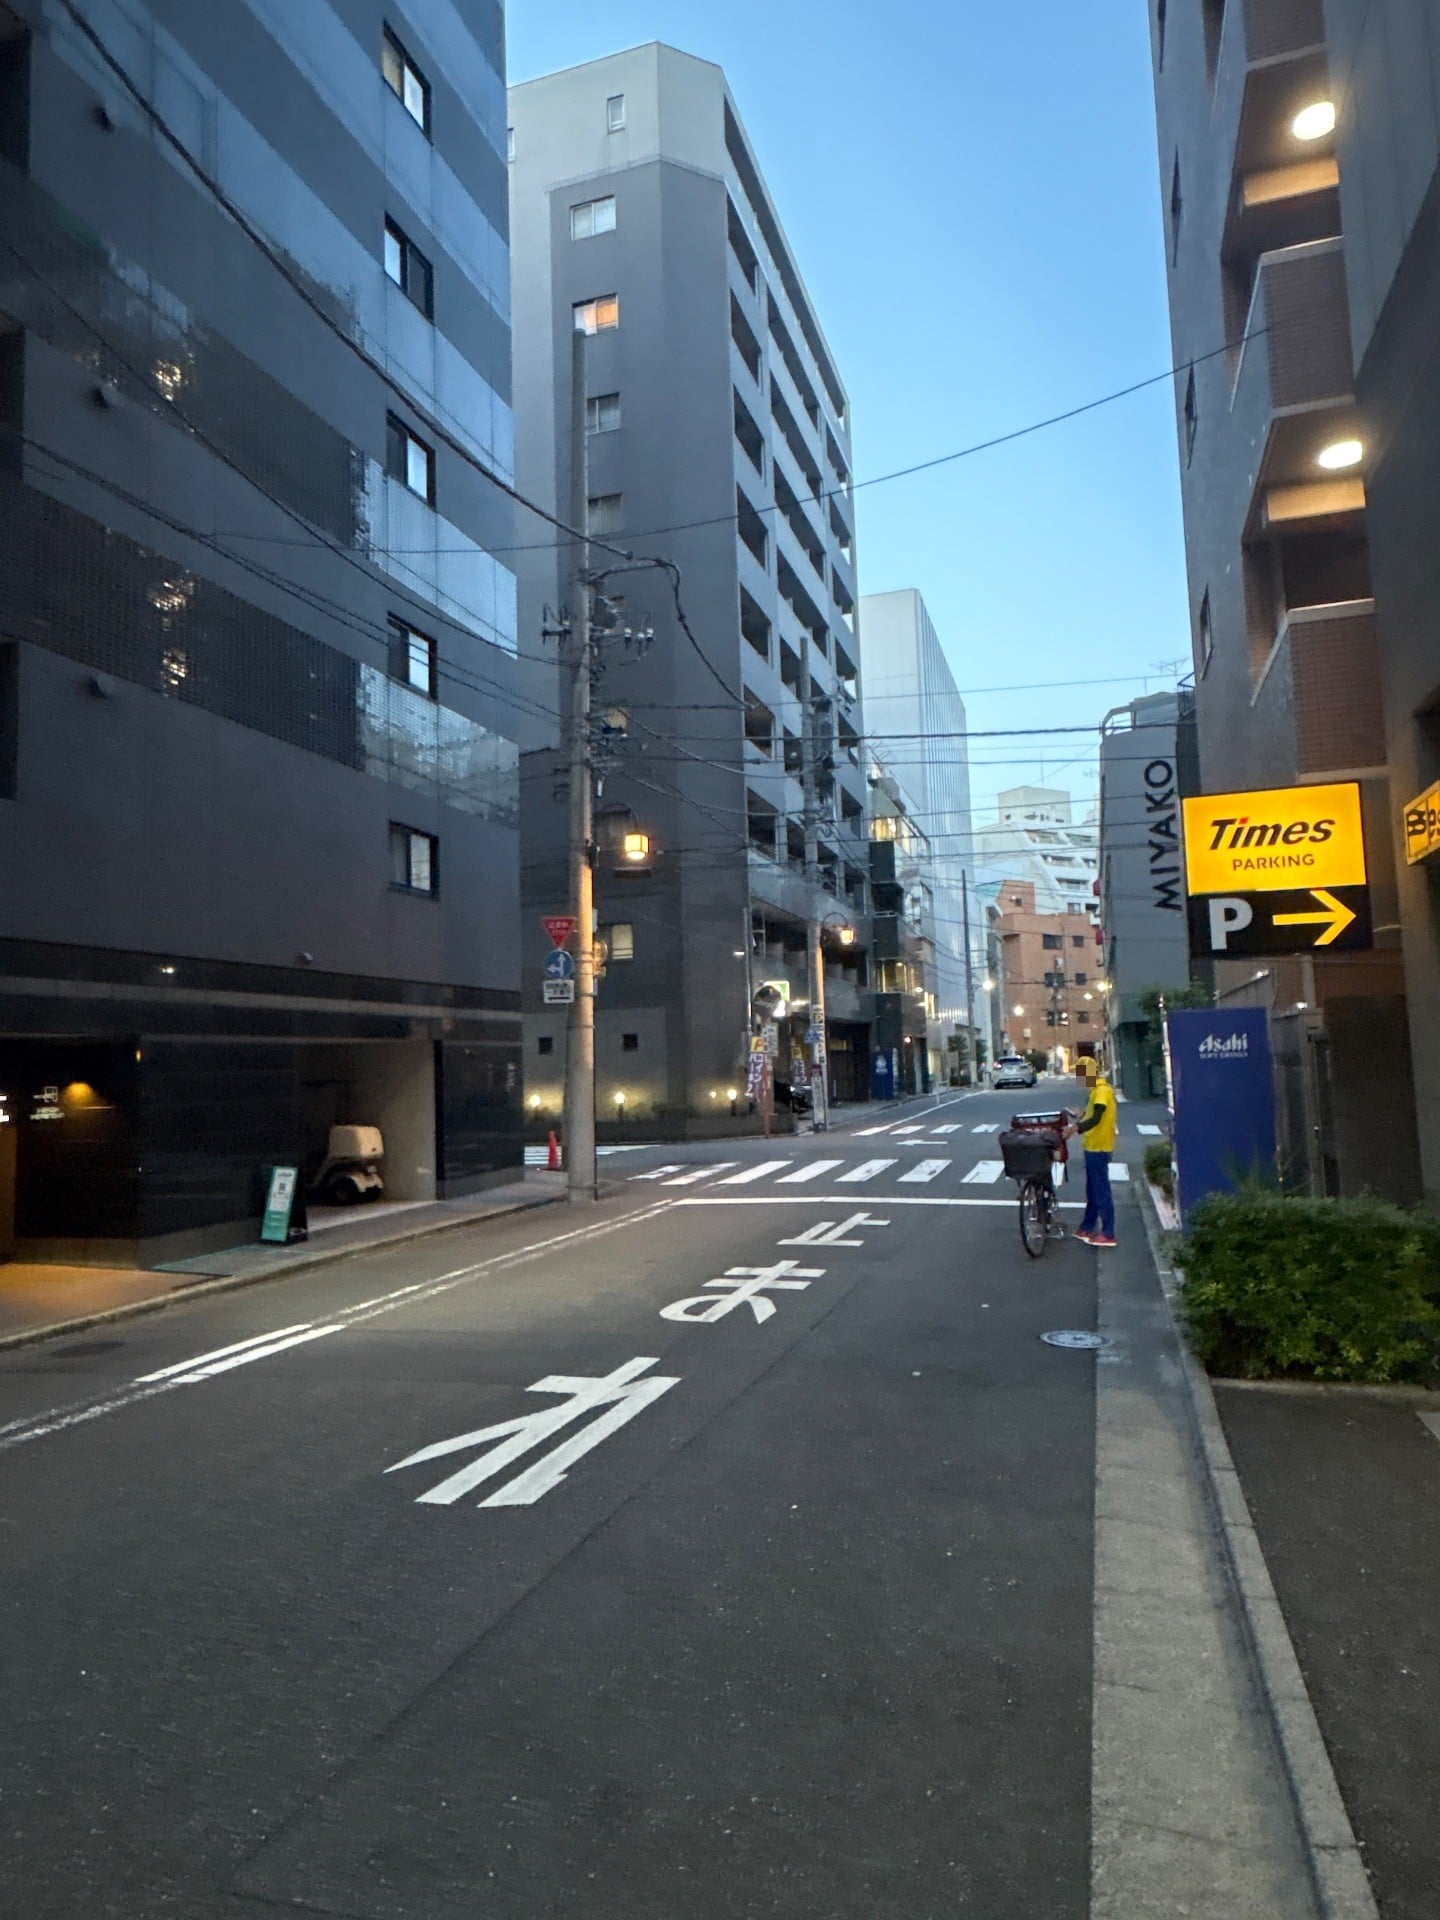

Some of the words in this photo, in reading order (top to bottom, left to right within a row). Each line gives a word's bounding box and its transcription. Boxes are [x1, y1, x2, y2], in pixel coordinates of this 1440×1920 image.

[1144, 760, 1182, 911] MIYAKO
[1210, 817, 1336, 850] Times
[1232, 854, 1315, 871] PARKING
[1208, 898, 1253, 950] P
[1199, 1033, 1248, 1052] Asahi
[383, 1212, 891, 1508] 止まれ
